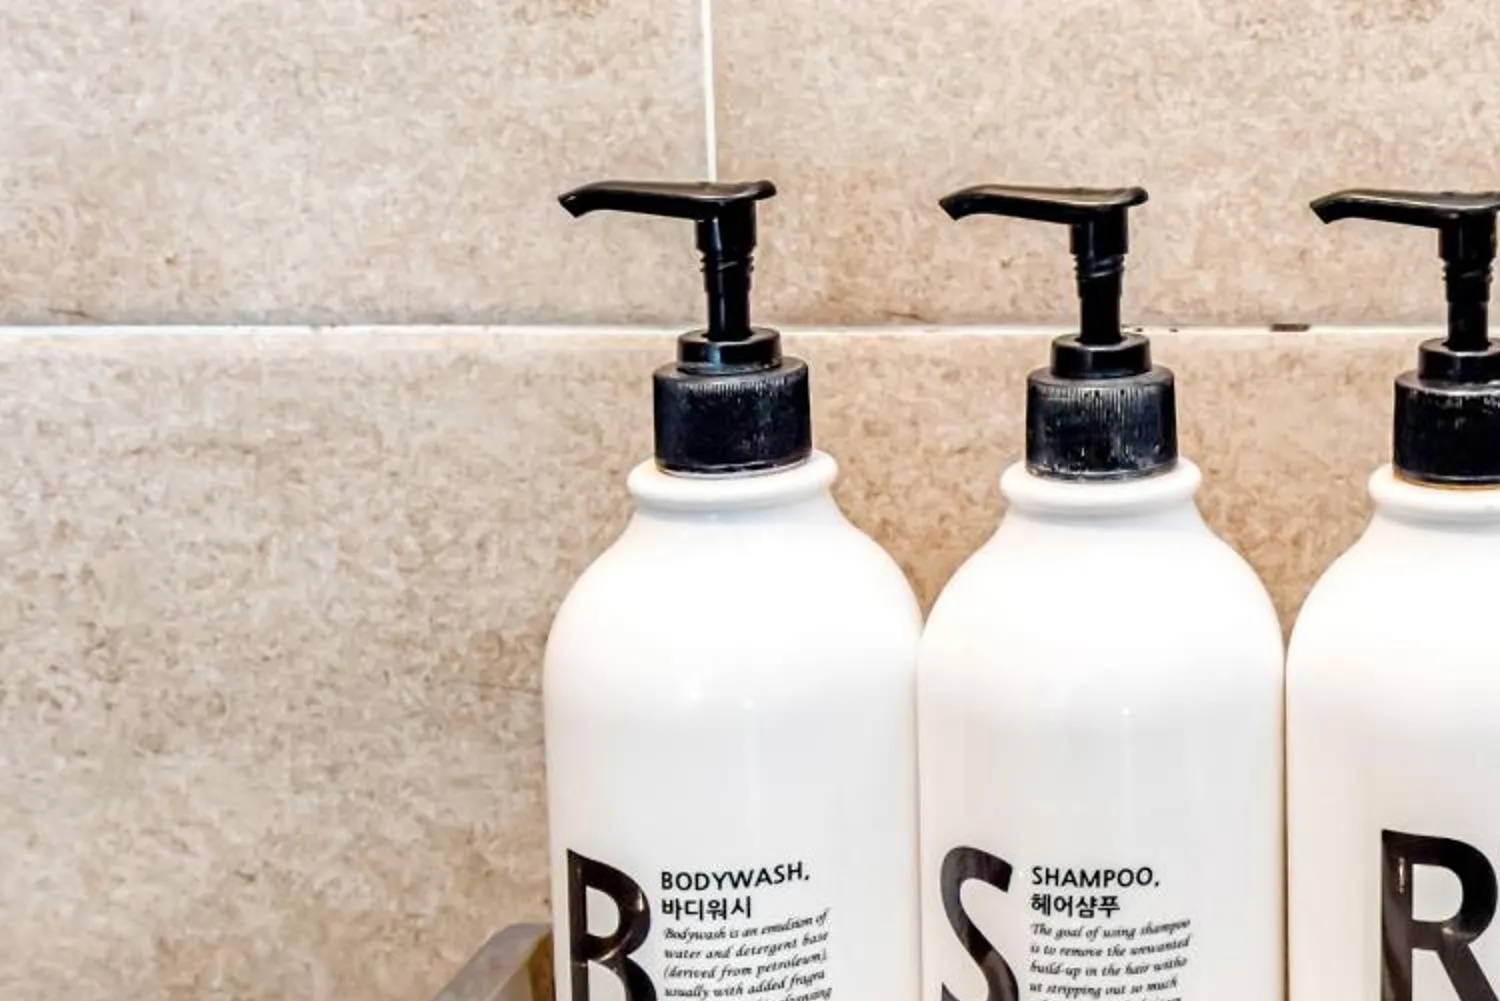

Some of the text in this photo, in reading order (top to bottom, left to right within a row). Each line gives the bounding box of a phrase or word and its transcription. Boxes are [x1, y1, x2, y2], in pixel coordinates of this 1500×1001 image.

[660, 896, 752, 921] 바디워시
[1030, 894, 1121, 918] 헤어샴푸
[664, 927, 726, 943] Bodywash
[1031, 923, 1052, 937] The
[1055, 925, 1083, 941] goal
[1086, 926, 1100, 942] of
[664, 949, 700, 959] water
[705, 945, 733, 959] and
[736, 938, 797, 956] detergent
[1107, 943, 1127, 957] the
[720, 965, 753, 983] from
[1101, 963, 1121, 976] the
[664, 984, 709, 1000] usually
[713, 984, 743, 996] with
[747, 979, 785, 995] added
[1046, 984, 1102, 999] stripping
